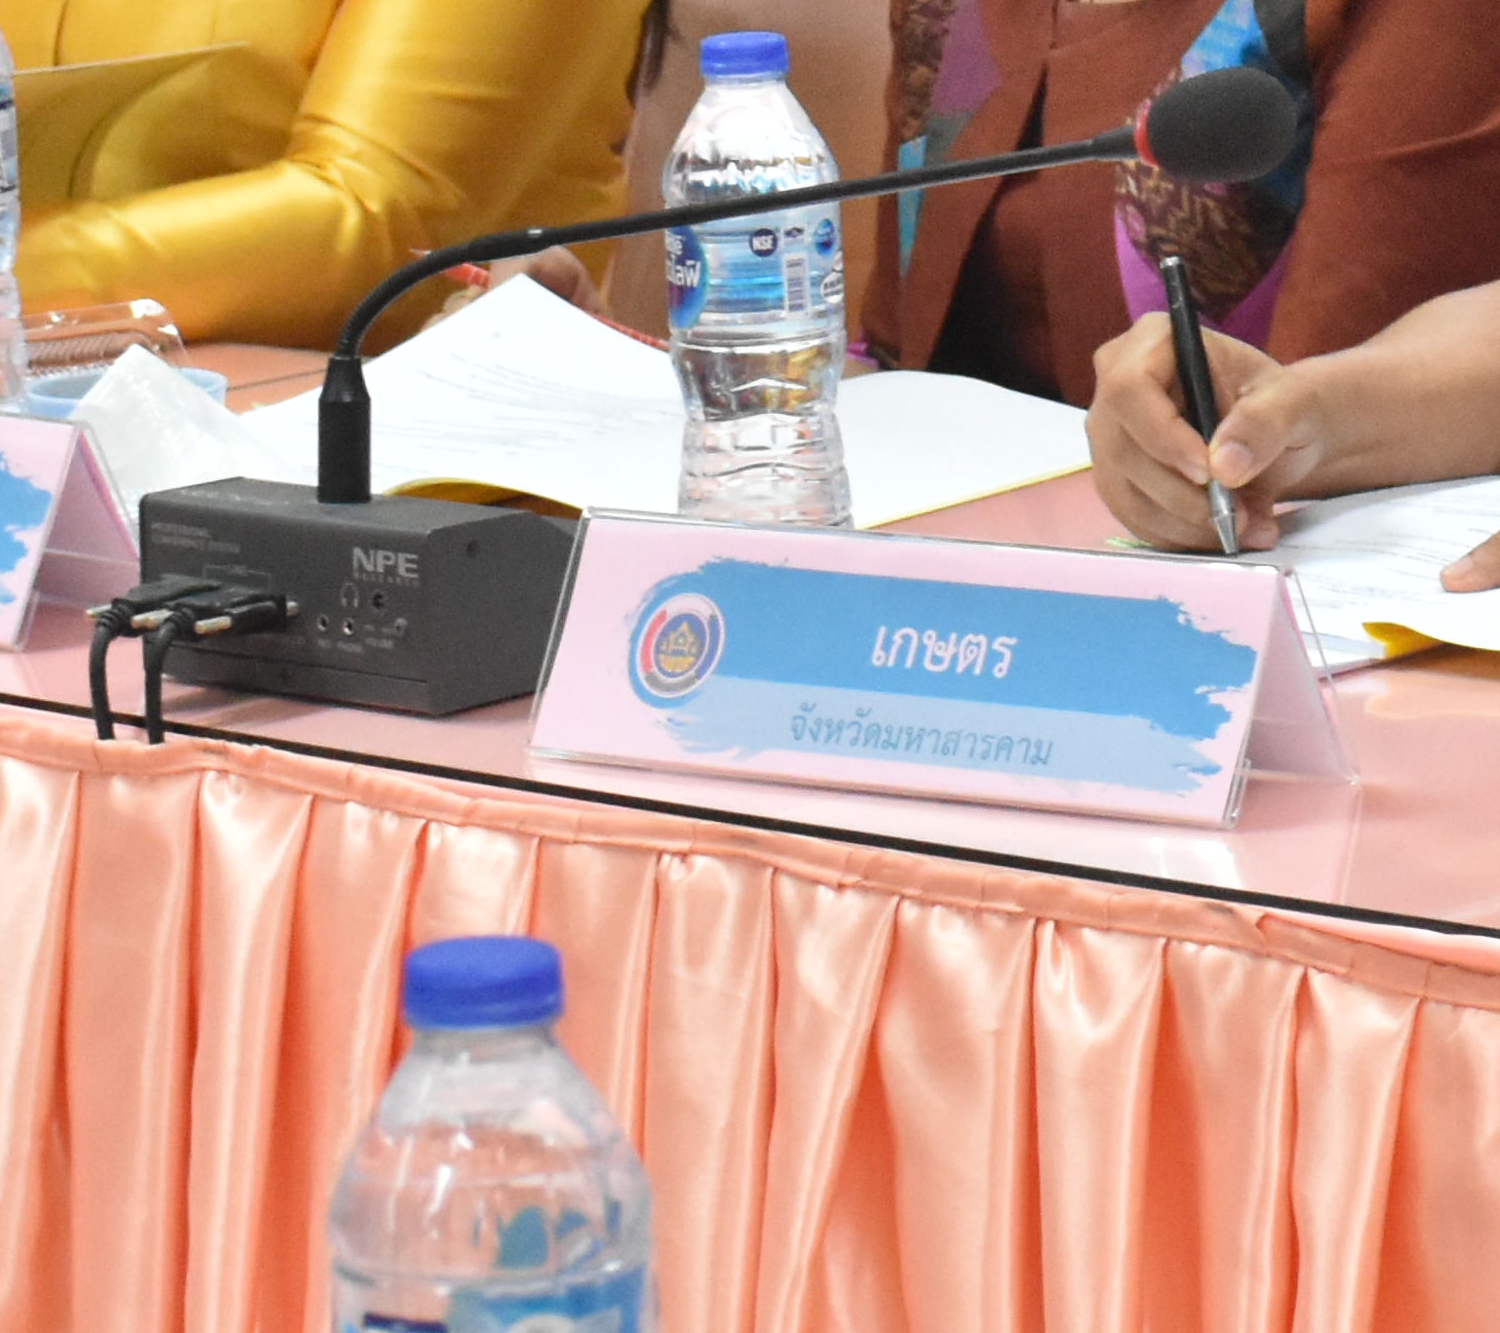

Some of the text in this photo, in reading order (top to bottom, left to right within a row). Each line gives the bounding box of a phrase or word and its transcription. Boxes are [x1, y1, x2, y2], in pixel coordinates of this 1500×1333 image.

[352, 546, 419, 579] NPE
[870, 624, 1018, 680] เกษตร
[789, 705, 1055, 768] จังหวัดมหาสารคาม
